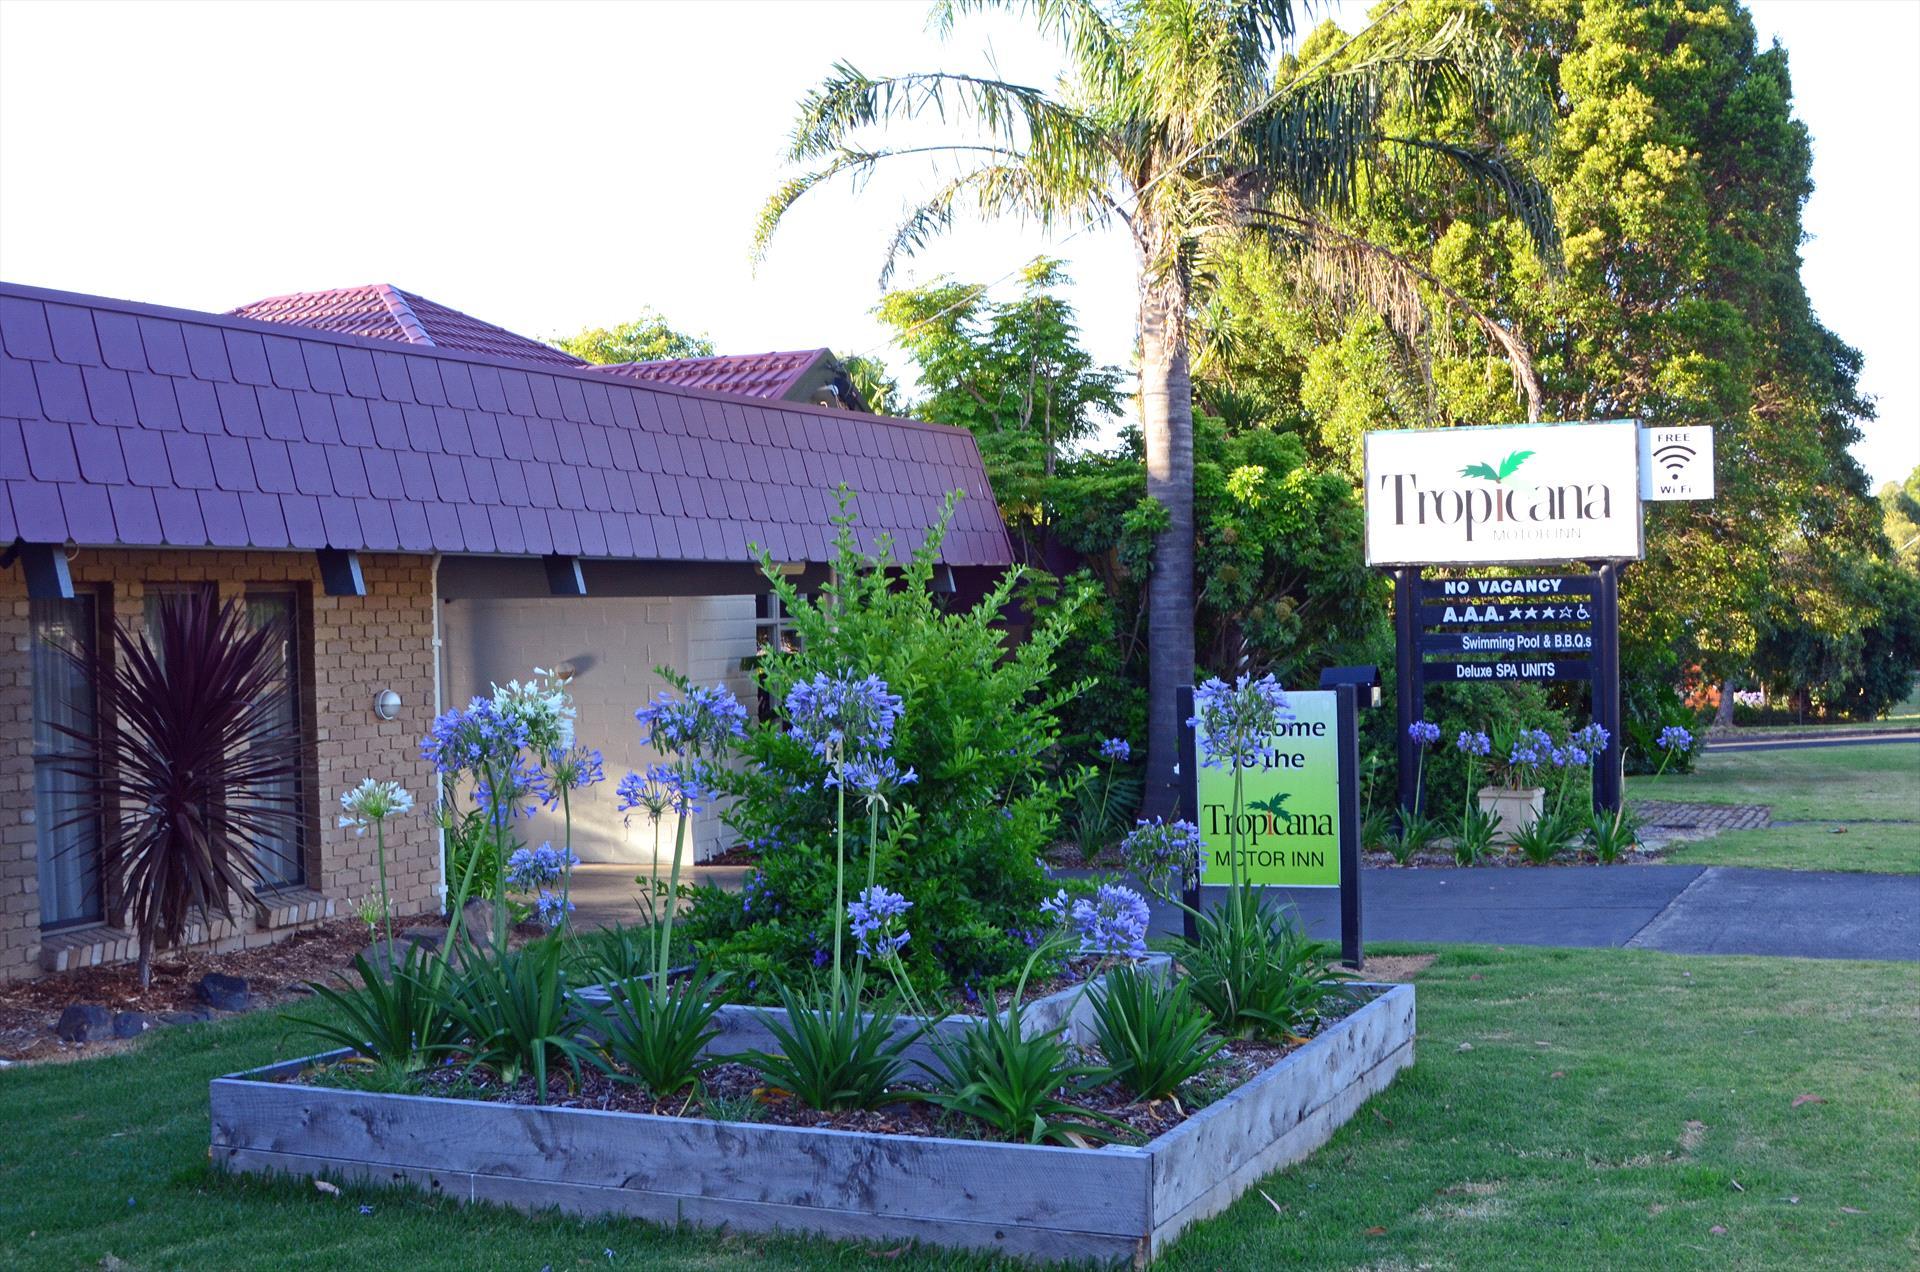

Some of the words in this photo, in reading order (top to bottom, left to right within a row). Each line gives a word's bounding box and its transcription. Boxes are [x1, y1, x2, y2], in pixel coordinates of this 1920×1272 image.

[1658, 433, 1690, 442] FREE
[1381, 474, 1611, 541] Tropicana
[1445, 582, 1469, 594] NO
[1478, 579, 1562, 594] VACANCY
[1443, 606, 1504, 622] A.A.A.
[1462, 636, 1514, 651] Swimming
[1517, 635, 1540, 649] Pool
[1543, 634, 1551, 648] &
[1456, 664, 1492, 678] Deluxe
[1496, 663, 1518, 677] SPA
[1521, 662, 1556, 677] UNITS
[1203, 804, 1334, 846] Tropicana
[1292, 850, 1324, 867] INN
